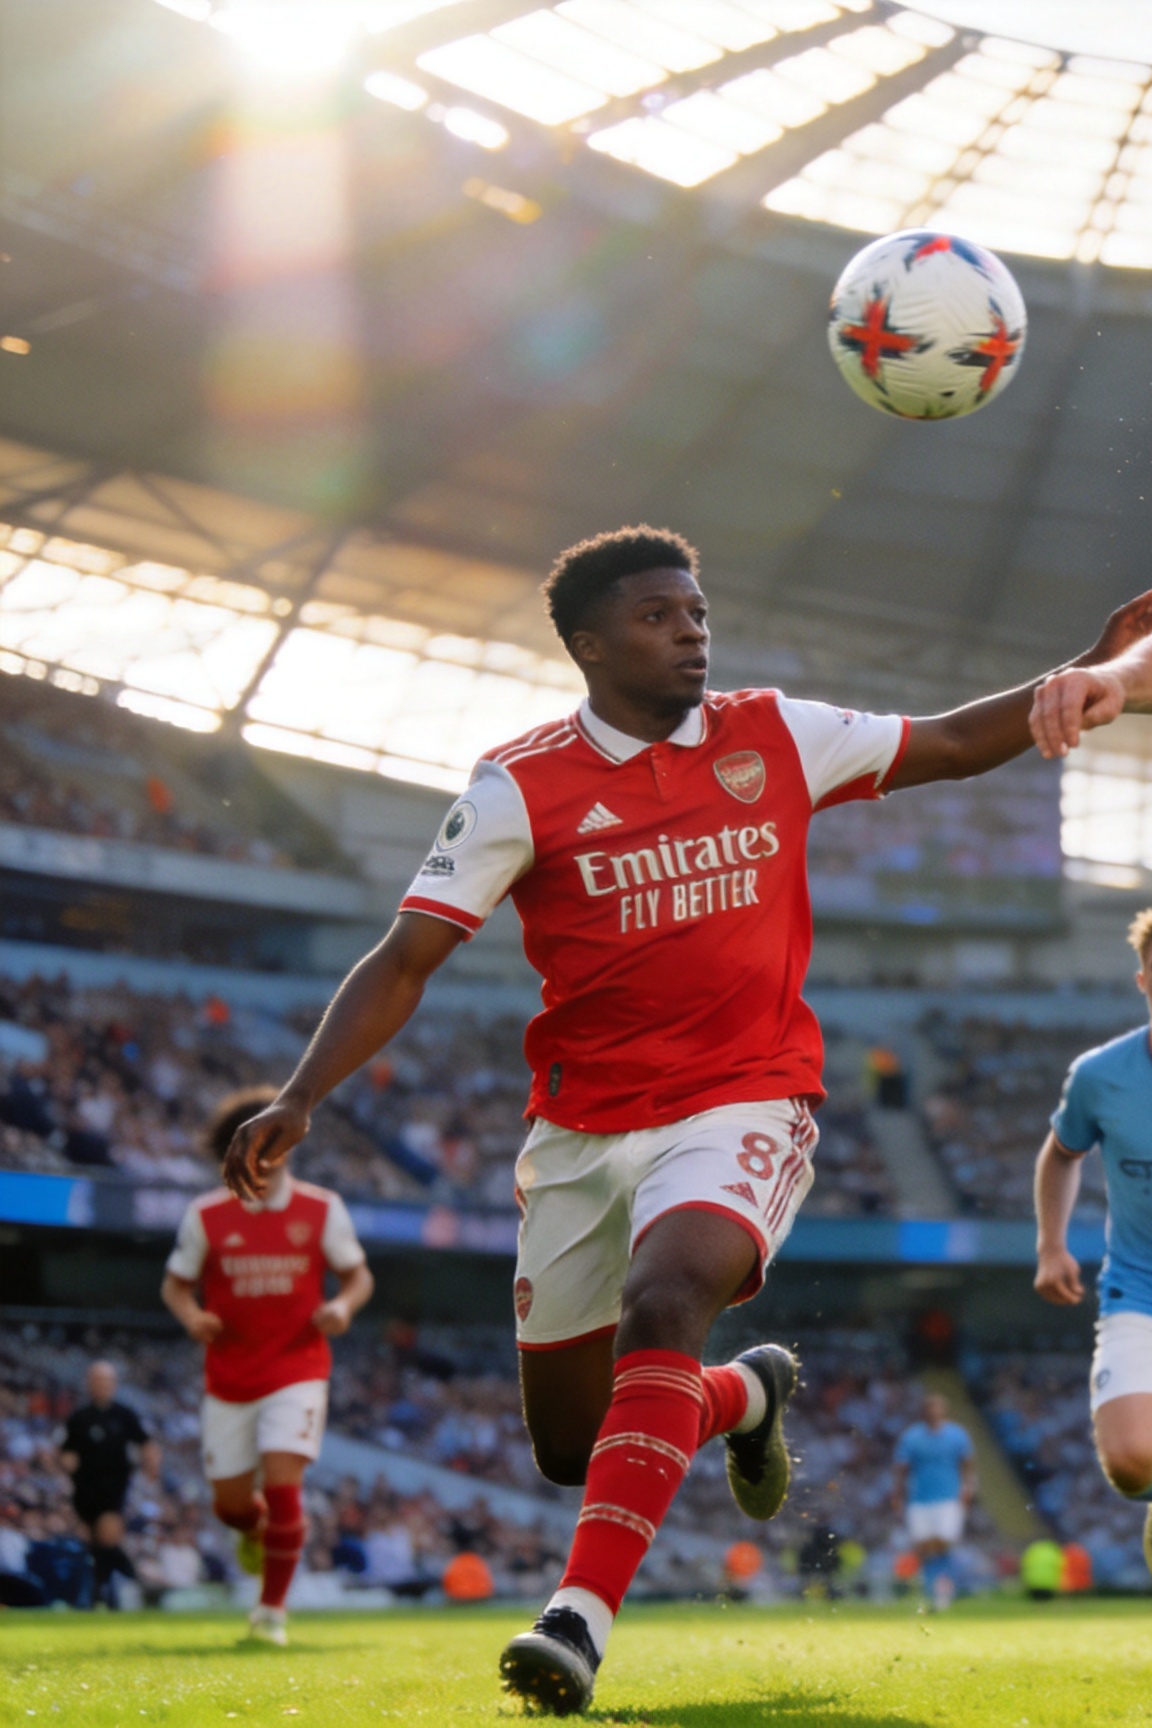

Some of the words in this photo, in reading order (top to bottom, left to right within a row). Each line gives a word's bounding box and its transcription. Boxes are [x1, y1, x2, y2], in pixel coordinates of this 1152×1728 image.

[573, 821, 780, 897] Emirates
[620, 888, 660, 934] FLY
[672, 868, 760, 922] BETTER
[736, 1131, 778, 1181] 8
